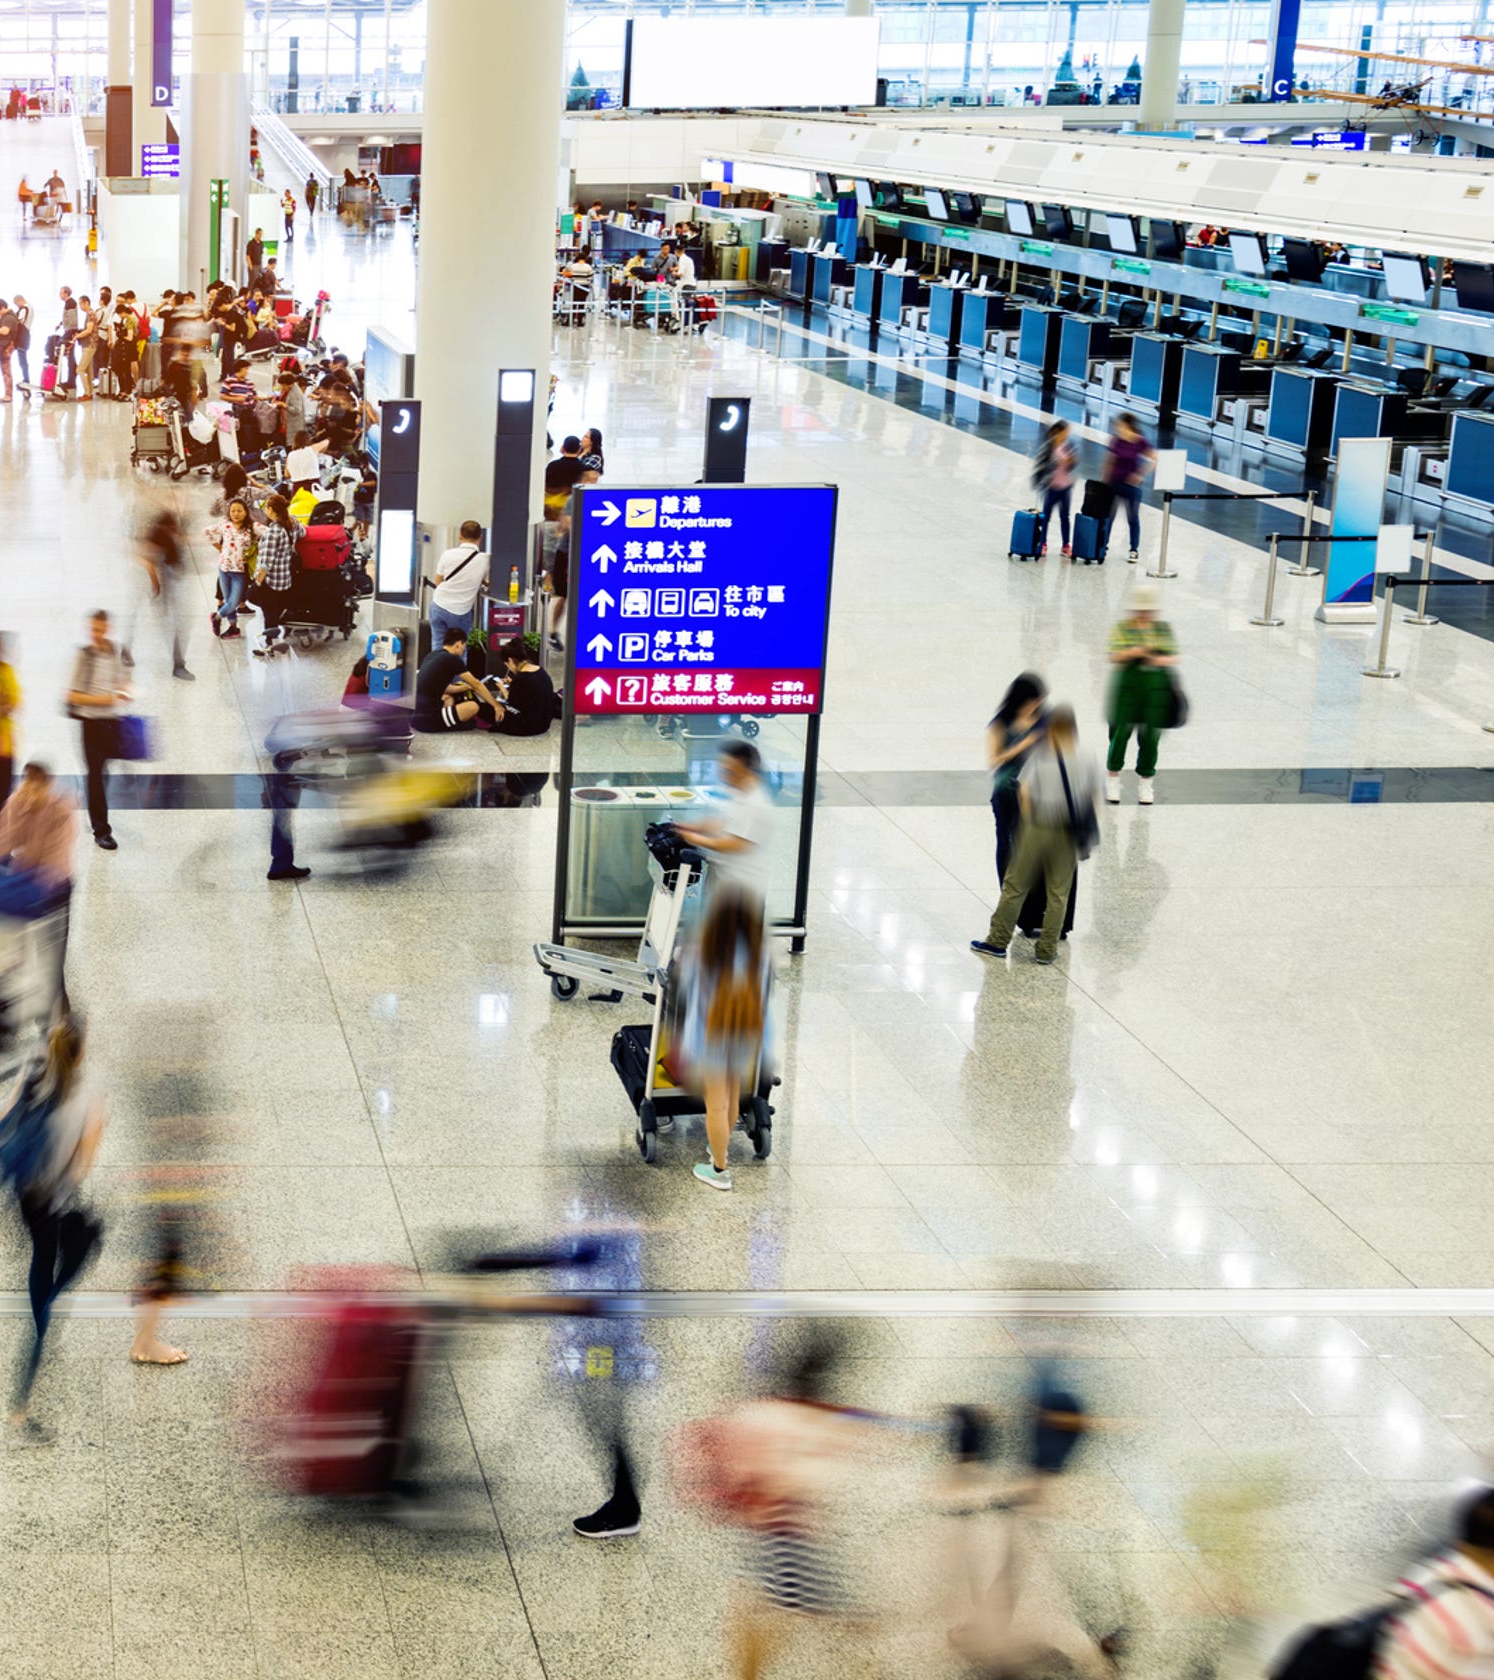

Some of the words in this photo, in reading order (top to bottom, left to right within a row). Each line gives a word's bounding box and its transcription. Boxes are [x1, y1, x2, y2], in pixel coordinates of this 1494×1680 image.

[155, 86, 169, 101] D
[1274, 79, 1289, 96] C
[660, 495, 702, 515] 離港
[659, 515, 733, 531] Departures
[623, 540, 707, 560] 接機大堂
[622, 560, 675, 574] Arrivals
[676, 560, 704, 574] Hall
[723, 584, 786, 604] 往市區
[723, 604, 741, 618] To
[741, 605, 768, 620] city
[653, 629, 715, 649] 停車場
[651, 648, 676, 662] Car
[677, 648, 715, 662] Parks
[651, 673, 735, 693] 旅客服務
[650, 692, 716, 706] Customer
[717, 692, 767, 706] Service
